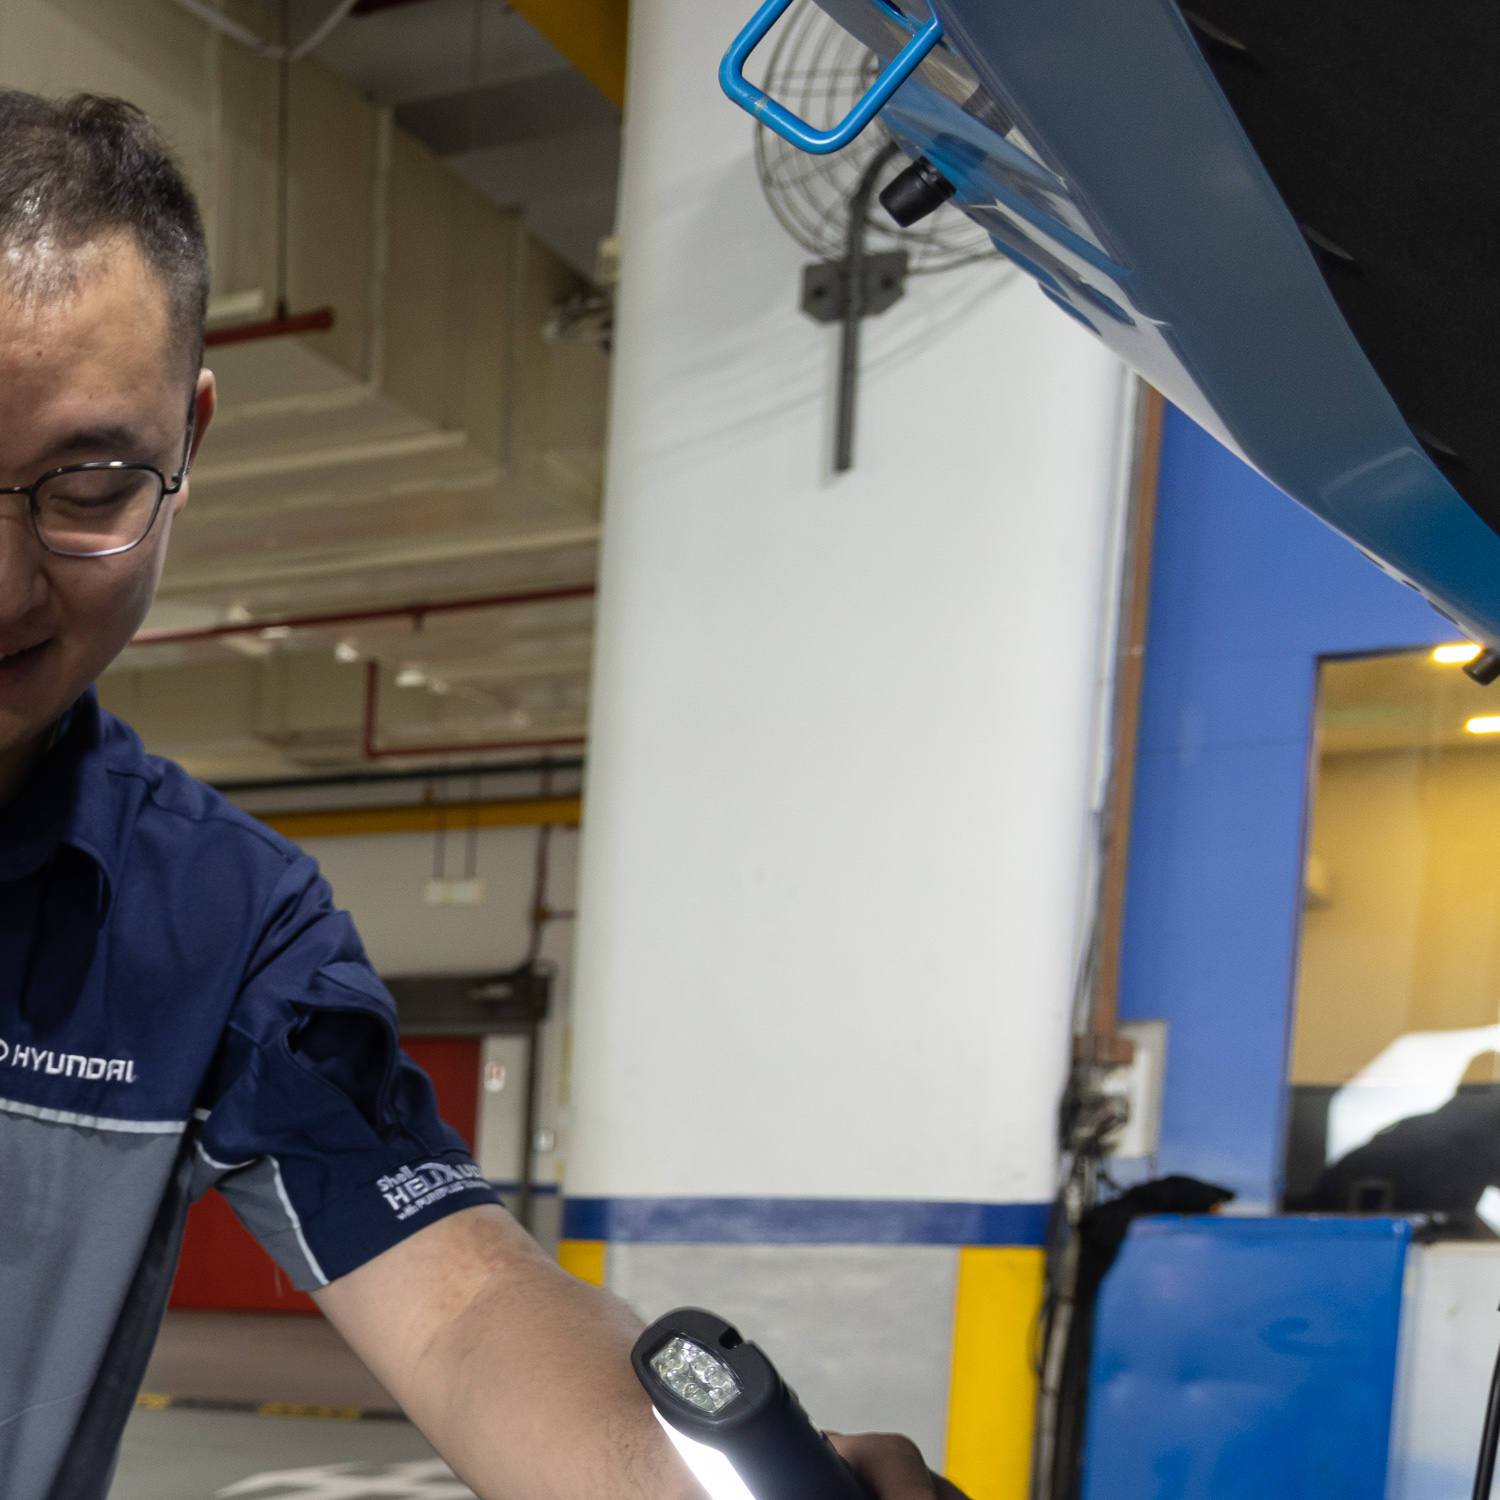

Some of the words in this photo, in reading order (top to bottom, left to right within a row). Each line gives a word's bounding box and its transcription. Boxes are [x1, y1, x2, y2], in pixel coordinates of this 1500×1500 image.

[11, 1044, 137, 1083] HYUNDAI
[376, 1165, 414, 1192] Shell
[382, 1162, 462, 1211] HELIX
